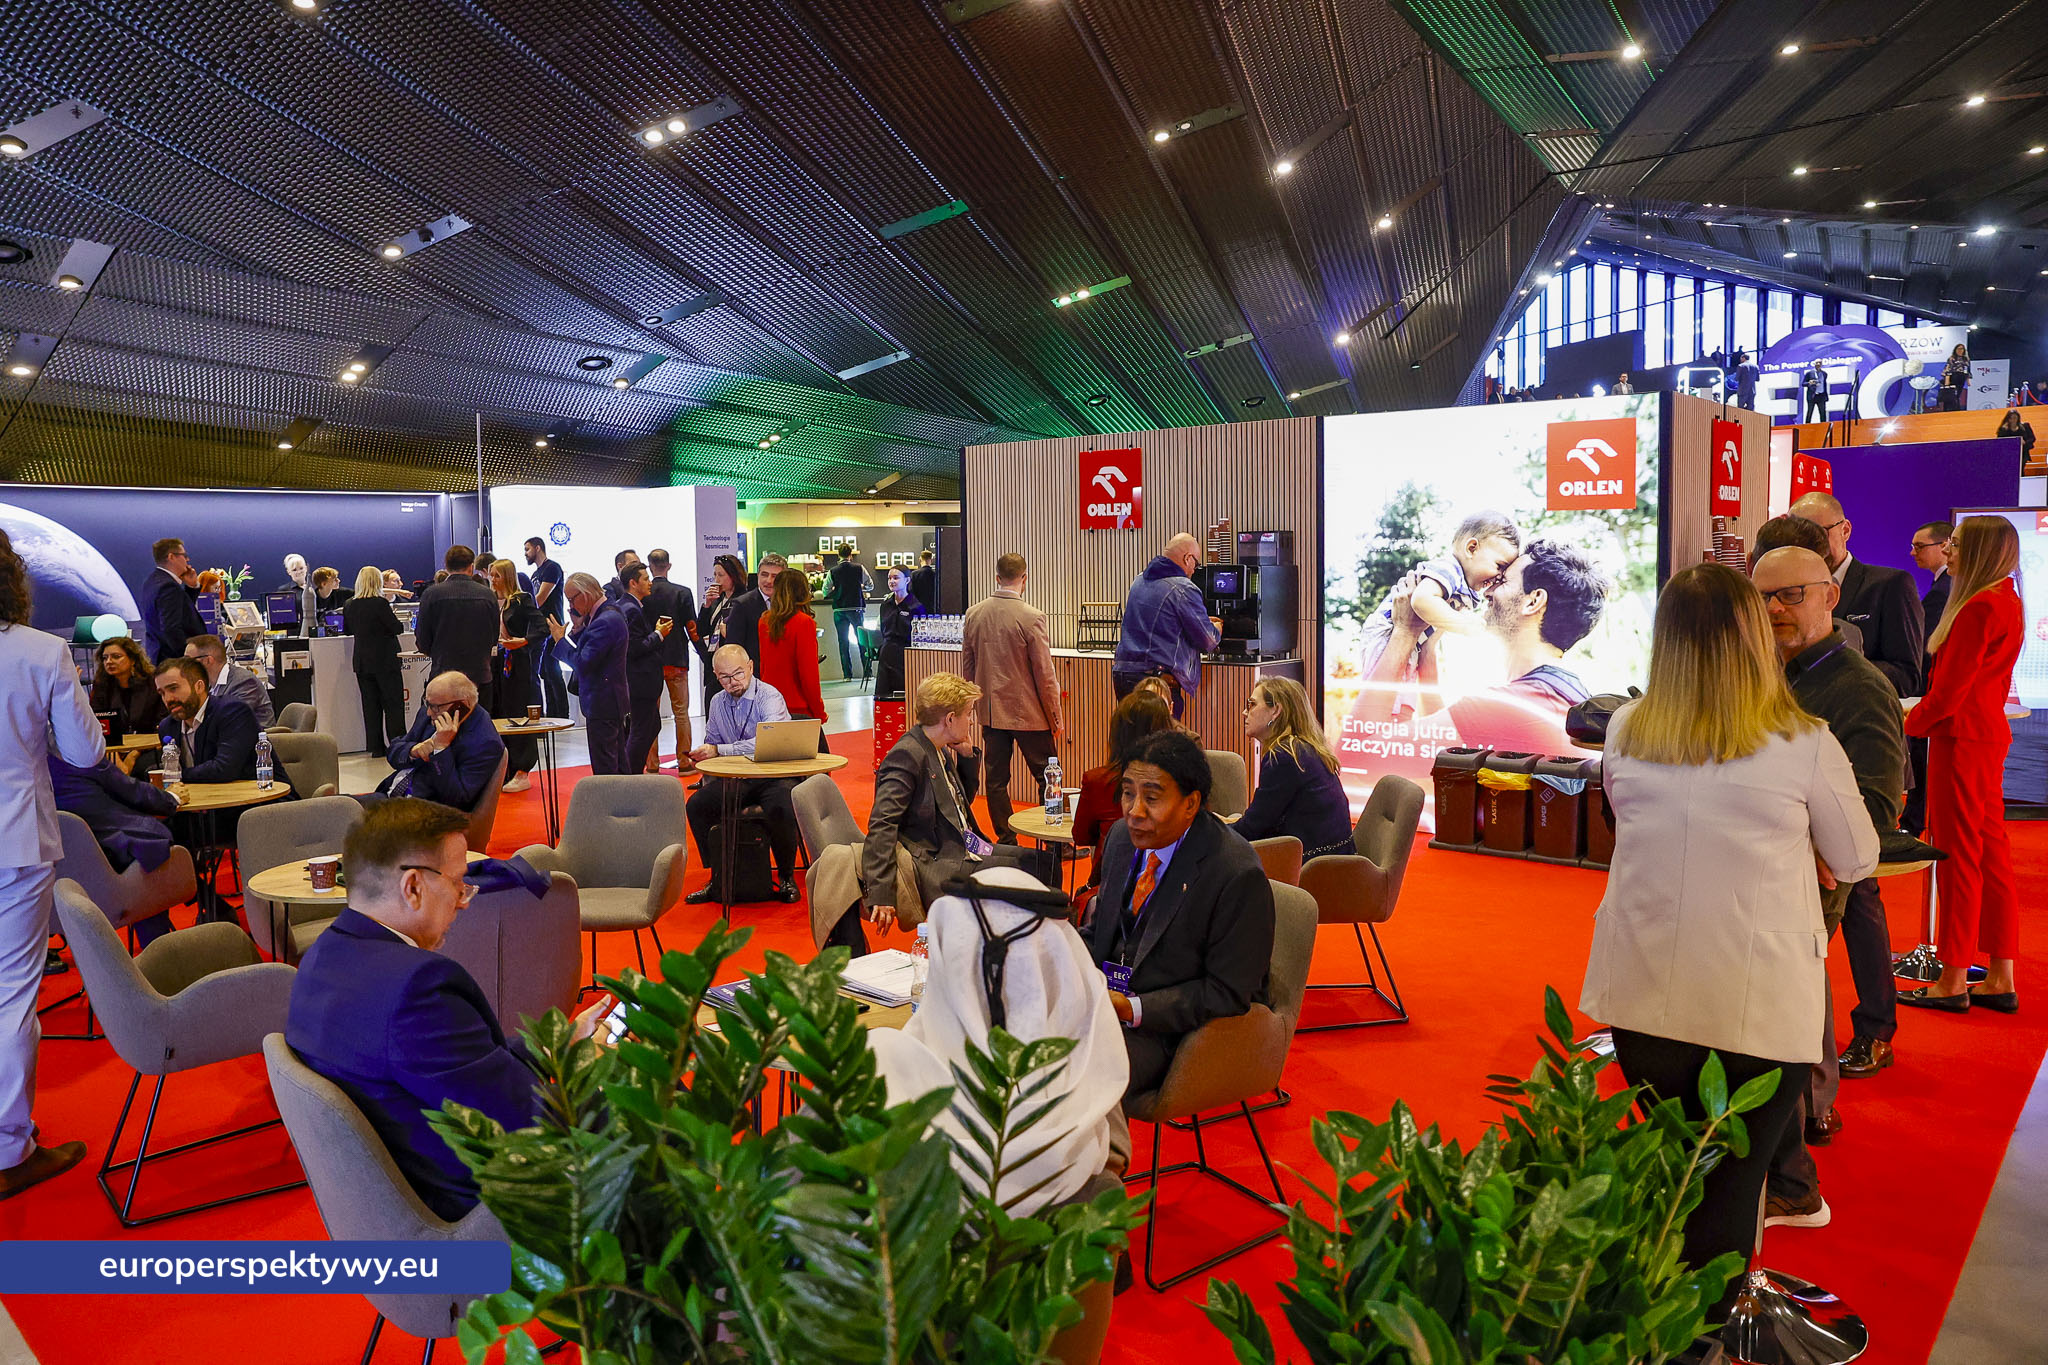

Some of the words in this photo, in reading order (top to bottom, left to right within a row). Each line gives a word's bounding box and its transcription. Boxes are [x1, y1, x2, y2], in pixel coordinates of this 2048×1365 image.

[1763, 363, 1780, 372] The
[1781, 360, 1810, 370] Power
[1822, 355, 1863, 366] Dialogue
[1756, 358, 1907, 427] EEC
[1559, 480, 1623, 497] ORLEN
[1719, 484, 1741, 502] ORLEN
[1087, 502, 1132, 517] ORLEN
[703, 534, 731, 542] Technologie
[1342, 714, 1408, 740] Energia
[1412, 721, 1458, 742] jutra
[1341, 737, 1415, 759] zaczyna
[1113, 971, 1126, 981] EEC
